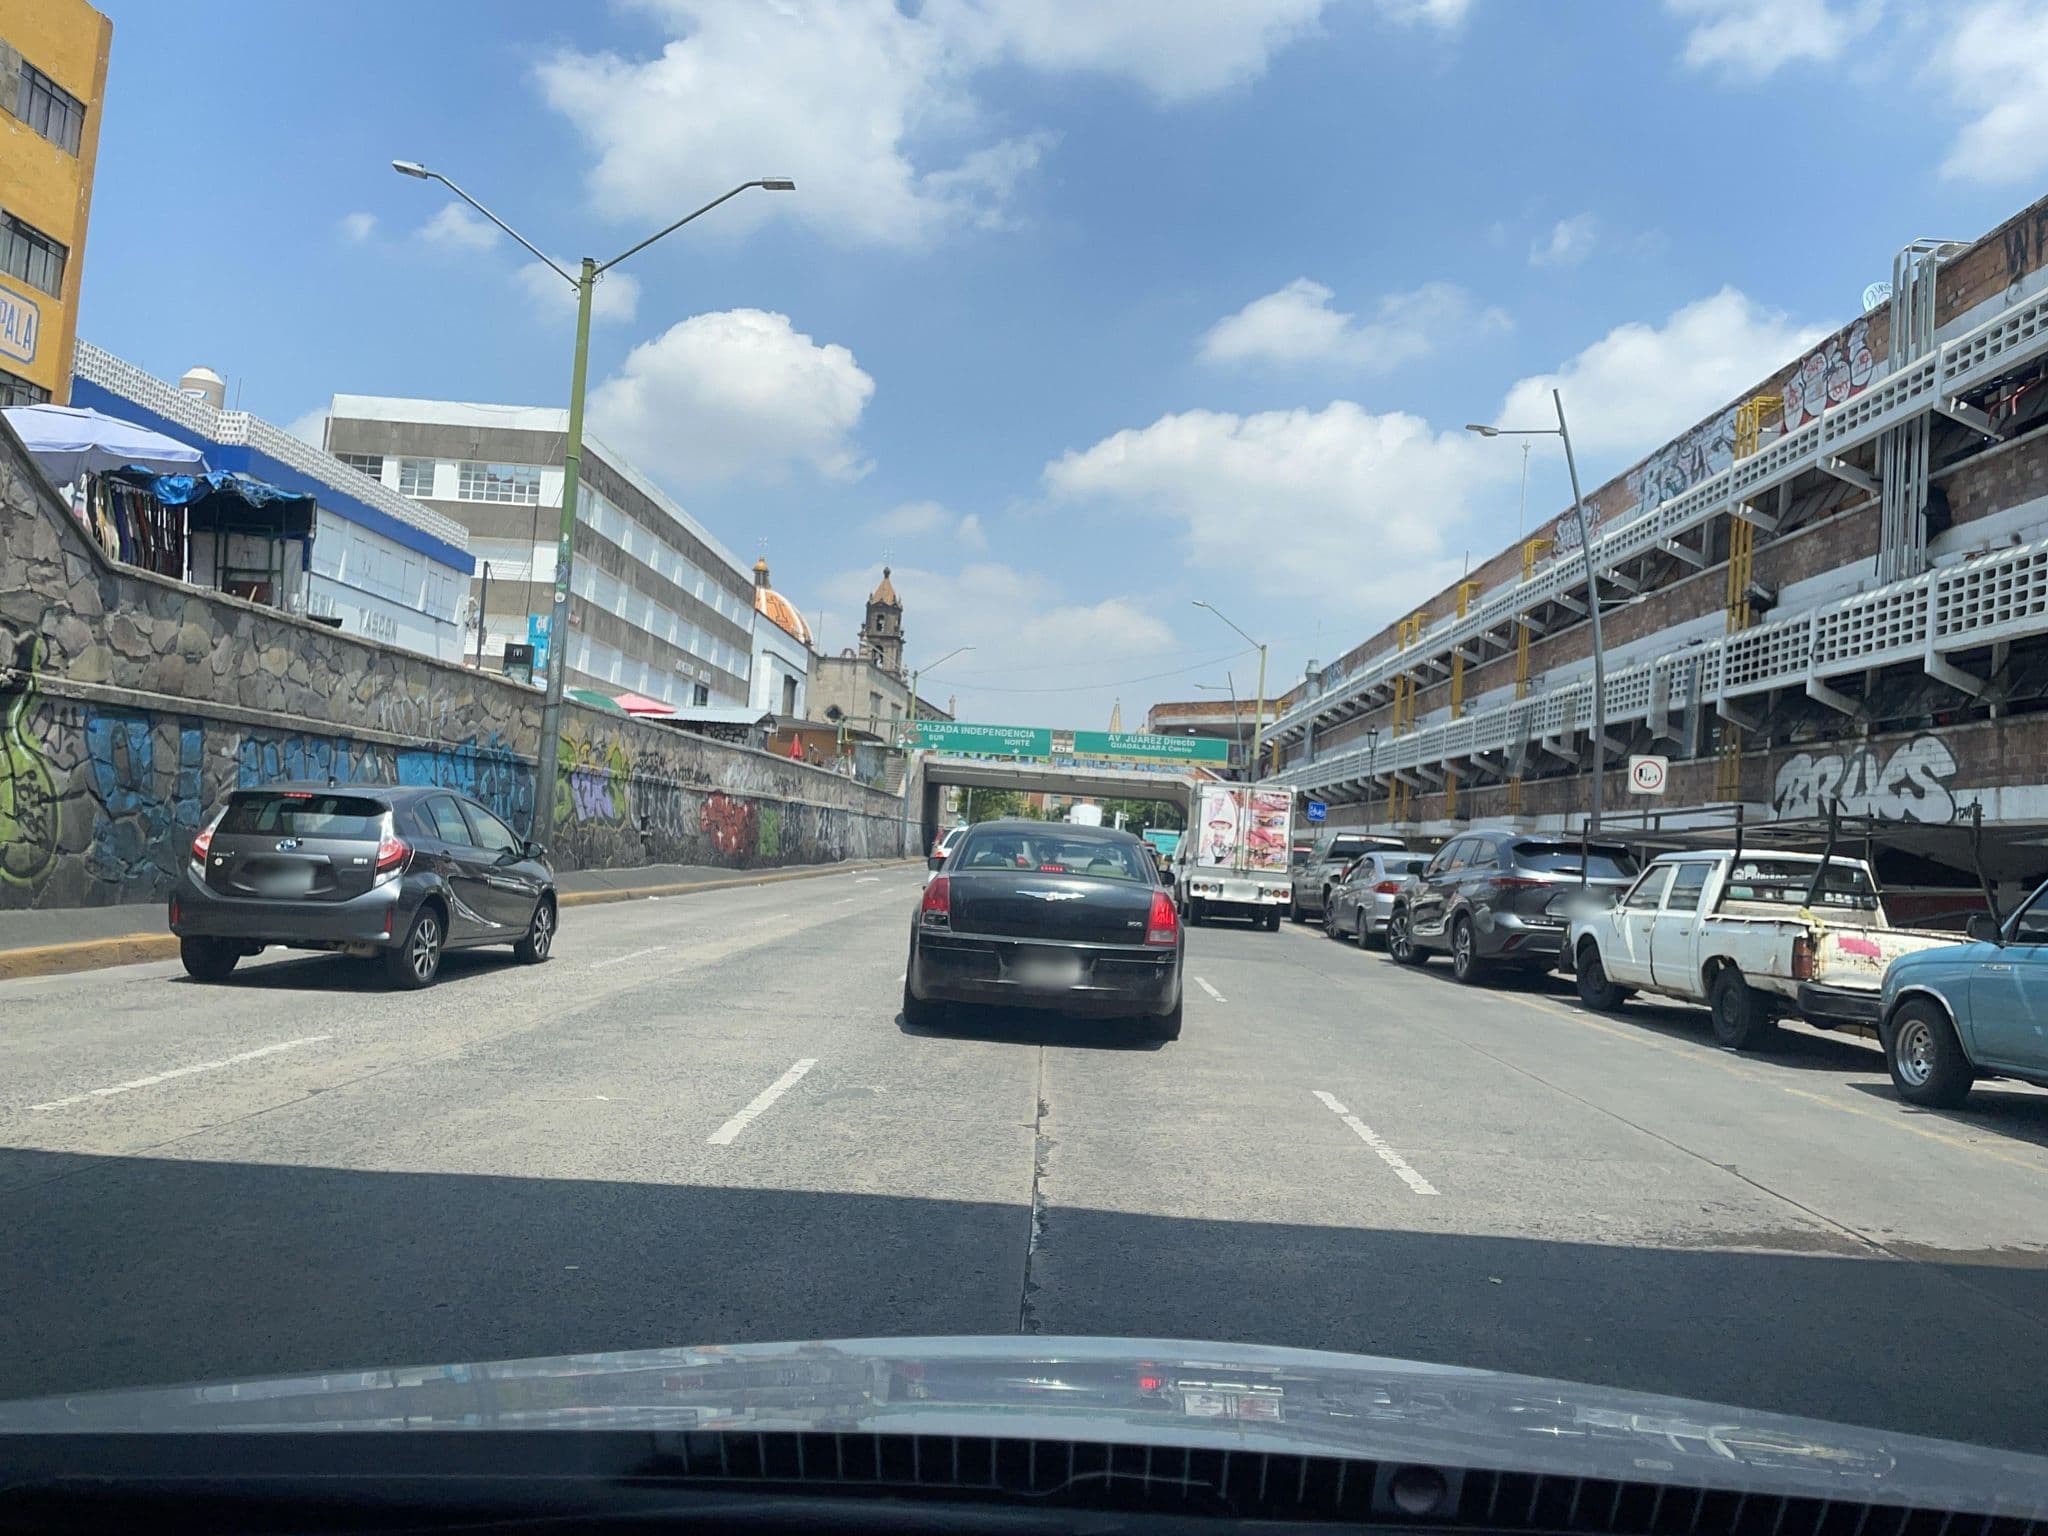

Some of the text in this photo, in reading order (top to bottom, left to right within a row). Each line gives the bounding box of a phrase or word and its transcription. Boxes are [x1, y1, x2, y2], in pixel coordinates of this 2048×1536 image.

[915, 723, 1036, 739] CALZADA INDEPENDENCIA
[928, 734, 945, 742] SUR
[1004, 738, 1031, 747] NORTE
[1163, 738, 1196, 747] Directo
[1110, 742, 1167, 752] GUADALAJARA
